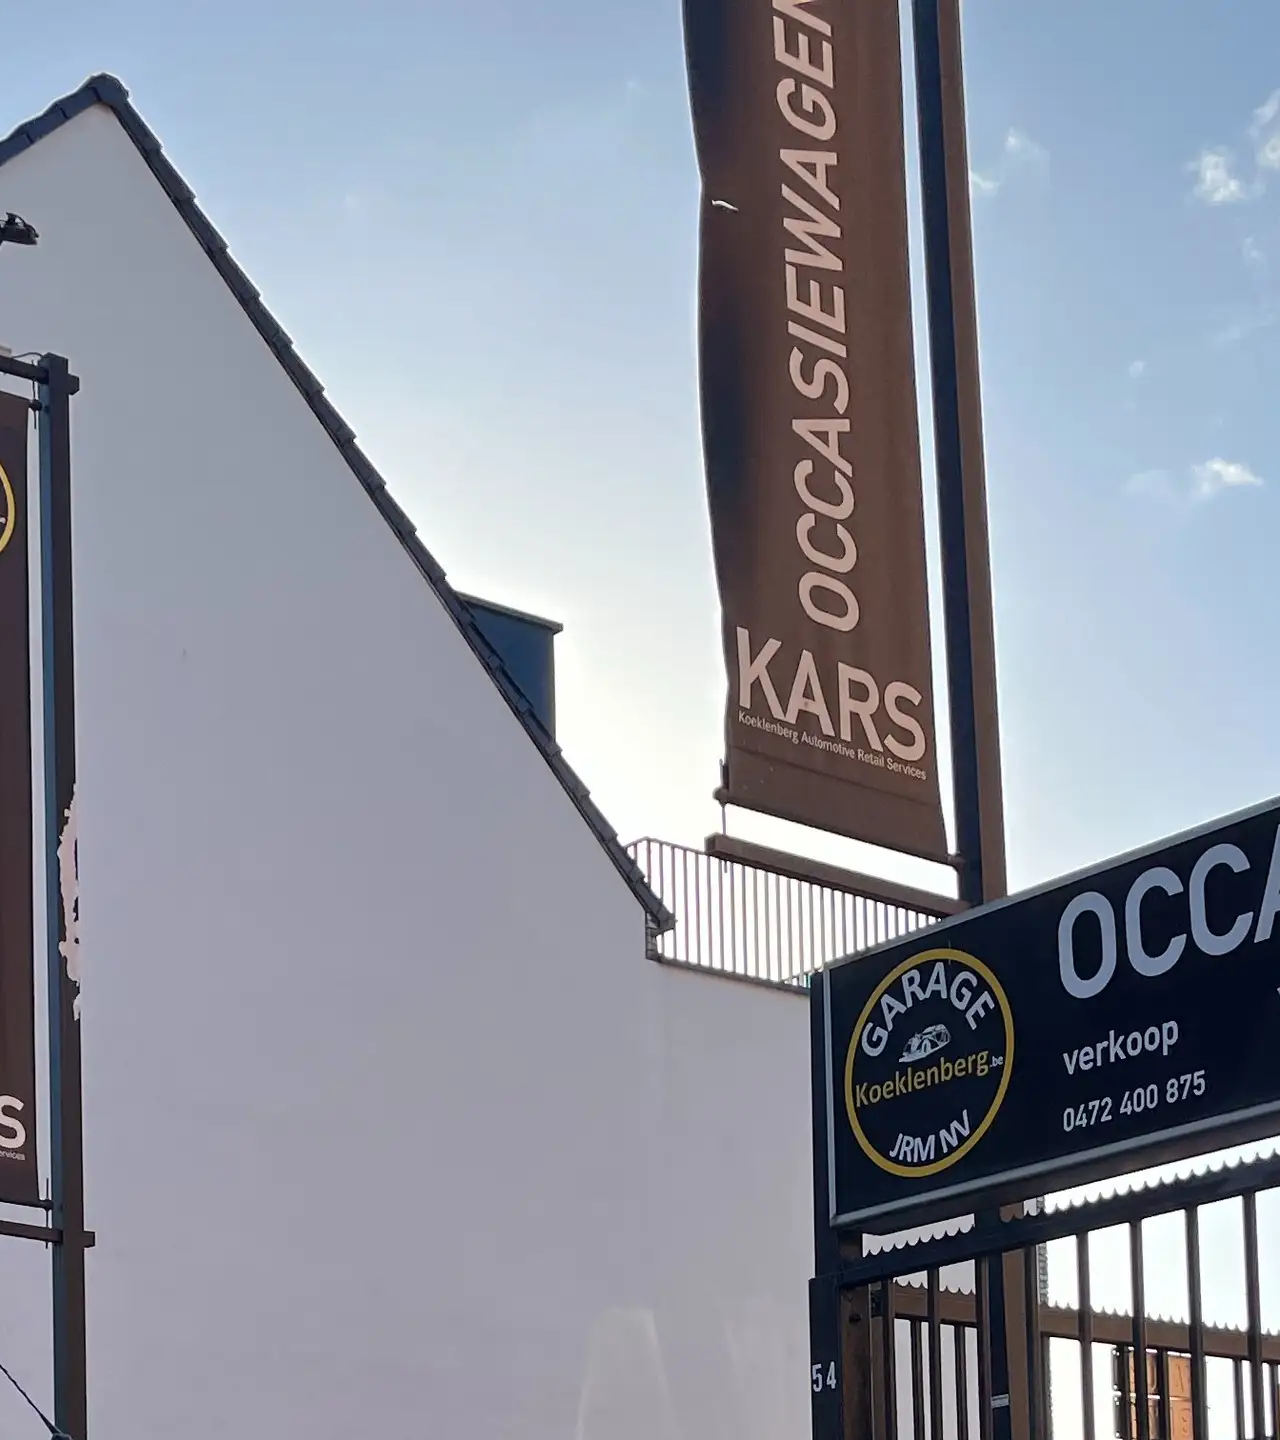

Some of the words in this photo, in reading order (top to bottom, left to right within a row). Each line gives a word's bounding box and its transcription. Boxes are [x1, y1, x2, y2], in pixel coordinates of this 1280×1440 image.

[736, 626, 926, 761] KARS
[738, 710, 799, 743] Koeklenberg
[801, 731, 855, 760] Automotive
[858, 748, 885, 768] Retail
[886, 757, 926, 780] Services
[861, 961, 995, 1057] GARAGE
[1062, 1020, 1179, 1075] verkoop
[1063, 1096, 1113, 1132] 0472
[1119, 1083, 1158, 1115] 400
[1165, 1069, 1206, 1103] 875
[889, 1132, 936, 1163] JRM
[939, 1109, 971, 1153] NV
[812, 1361, 837, 1392] 54
